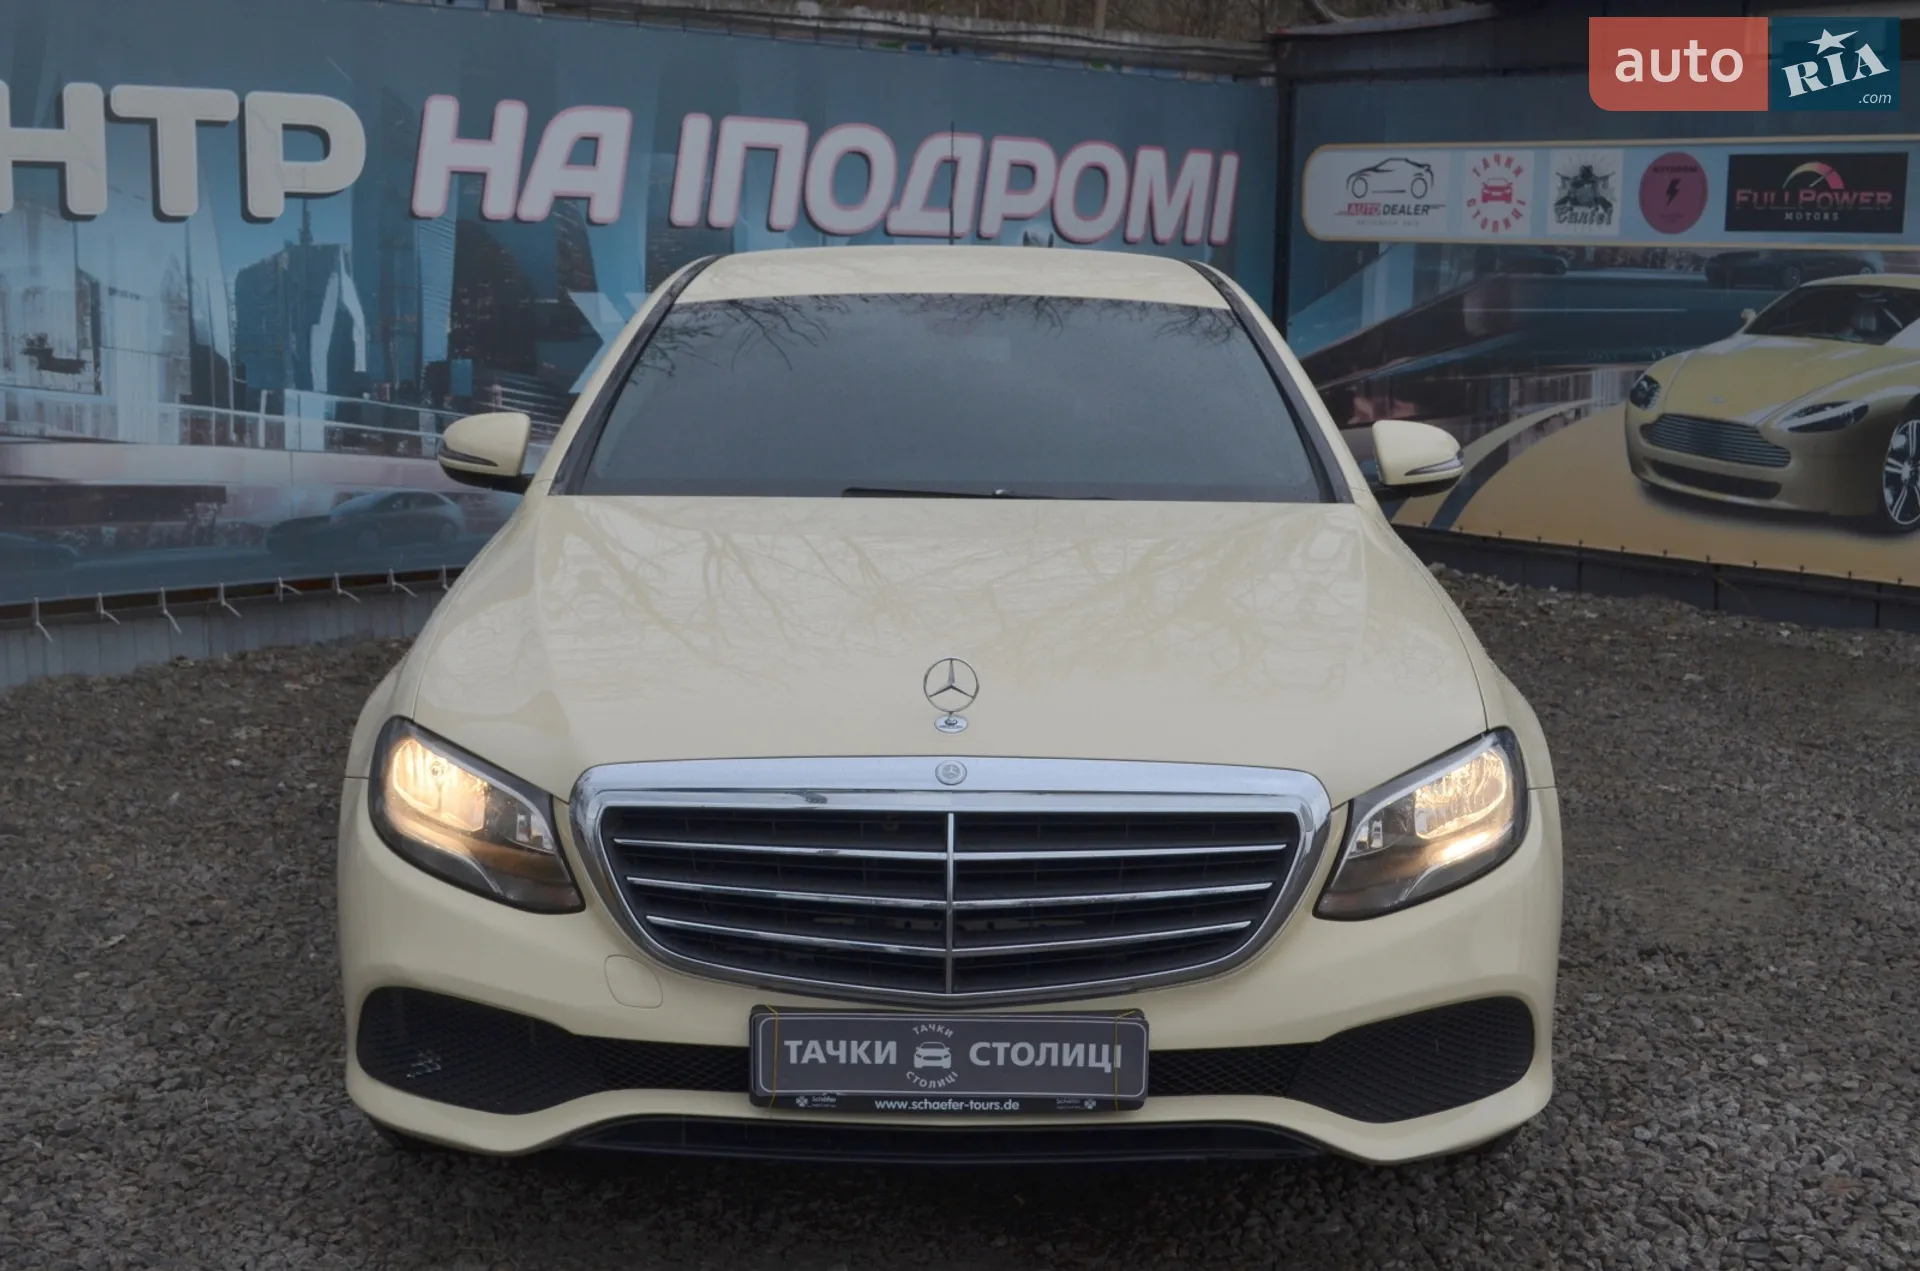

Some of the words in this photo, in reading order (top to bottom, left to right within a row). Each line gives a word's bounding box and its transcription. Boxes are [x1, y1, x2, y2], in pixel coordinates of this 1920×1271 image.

[411, 94, 633, 224] НА
[669, 112, 1240, 245] ІПОДРОМІ
[1472, 153, 1524, 178] ТАЧКИ
[1382, 204, 1430, 216] DEALER
[1466, 198, 1527, 234] СТОЛИЦІ
[1784, 212, 1840, 221] MOTORS
[912, 1023, 954, 1038] ТАЧКИ
[784, 1040, 897, 1065] ТАЧКИ
[968, 1042, 1122, 1073] СТОЛИЦІ
[906, 1070, 959, 1089] СТОЛИЦІ
[874, 1098, 1020, 1112] www.schaefer-tours.de
